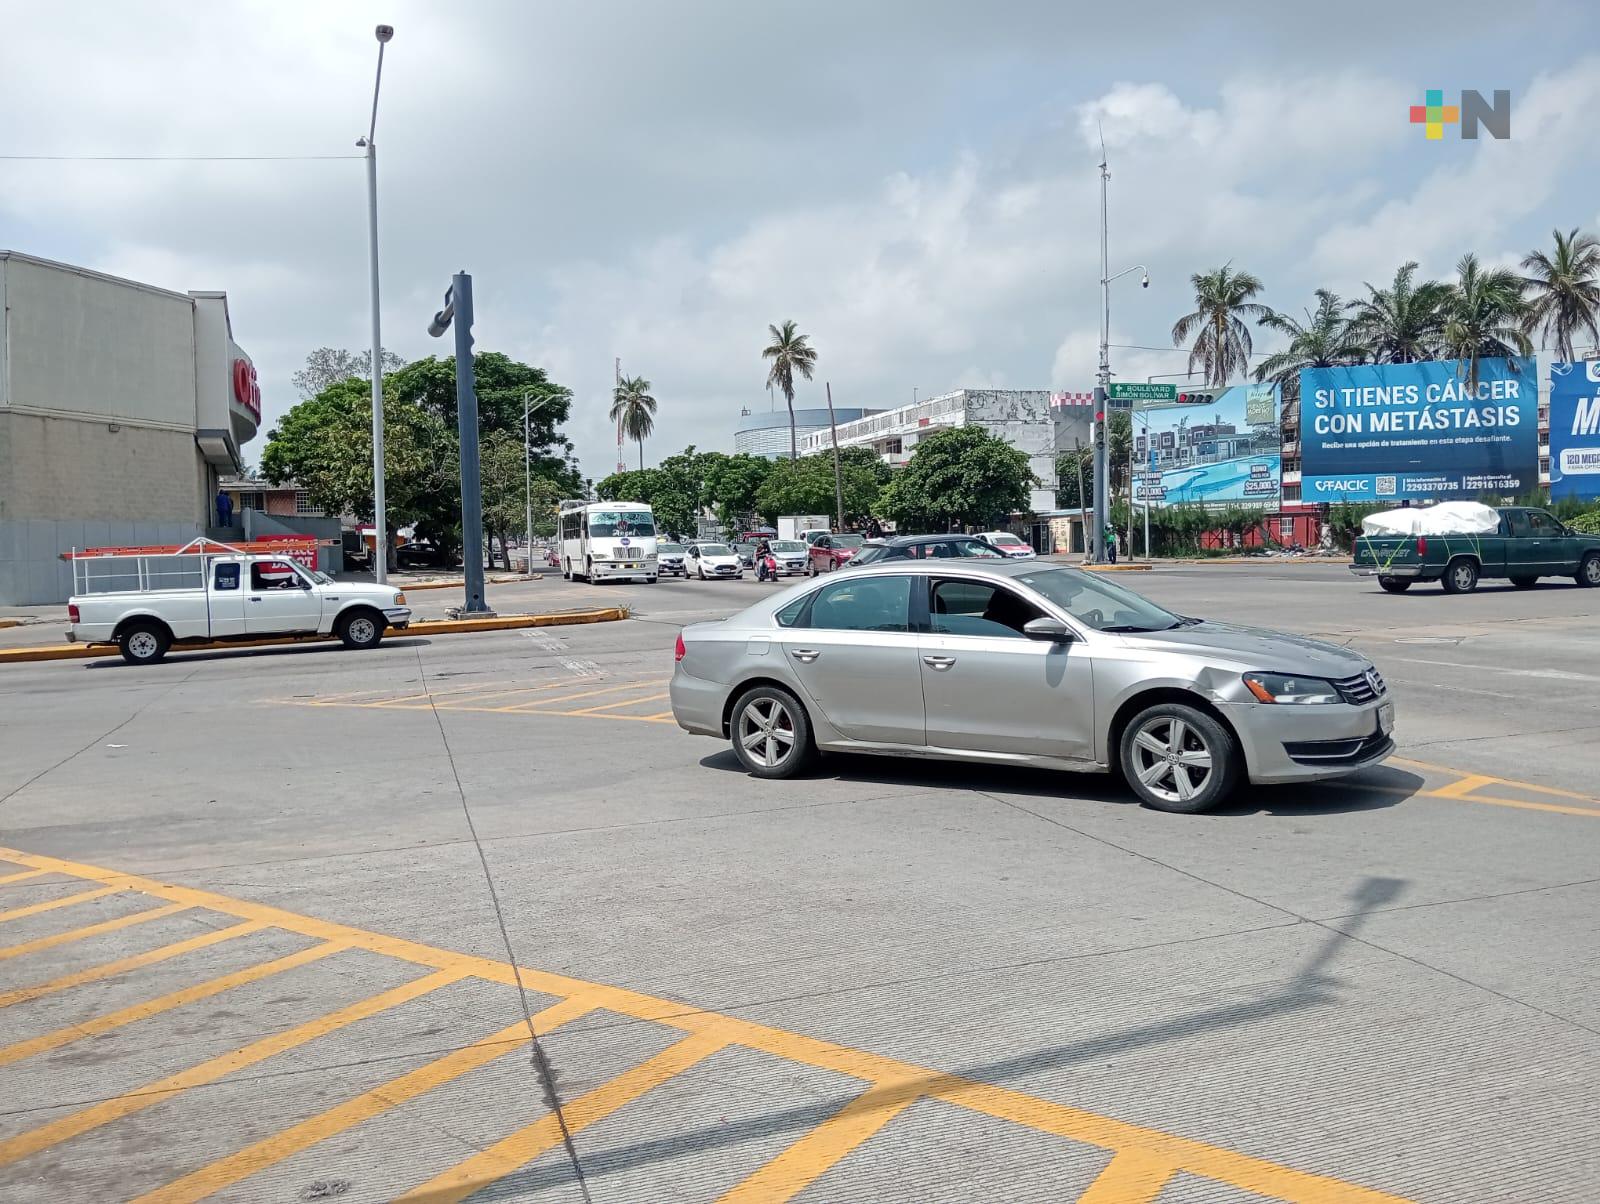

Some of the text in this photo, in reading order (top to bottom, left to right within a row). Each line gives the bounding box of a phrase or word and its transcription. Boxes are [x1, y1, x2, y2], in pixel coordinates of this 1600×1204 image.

[1126, 385, 1171, 393] BOULEVARD
[1315, 378, 1519, 408] SI TIENES CÁNCER
[1314, 405, 1520, 434] CON METÁSTASIS
[1358, 440, 1380, 449] opción
[1390, 438, 1429, 447] tratamiento
[1455, 437, 1474, 445] etapa
[1567, 454, 1580, 465] 120
[1406, 481, 1459, 492] 2293370735
[1466, 479, 1520, 490] 2291616359
